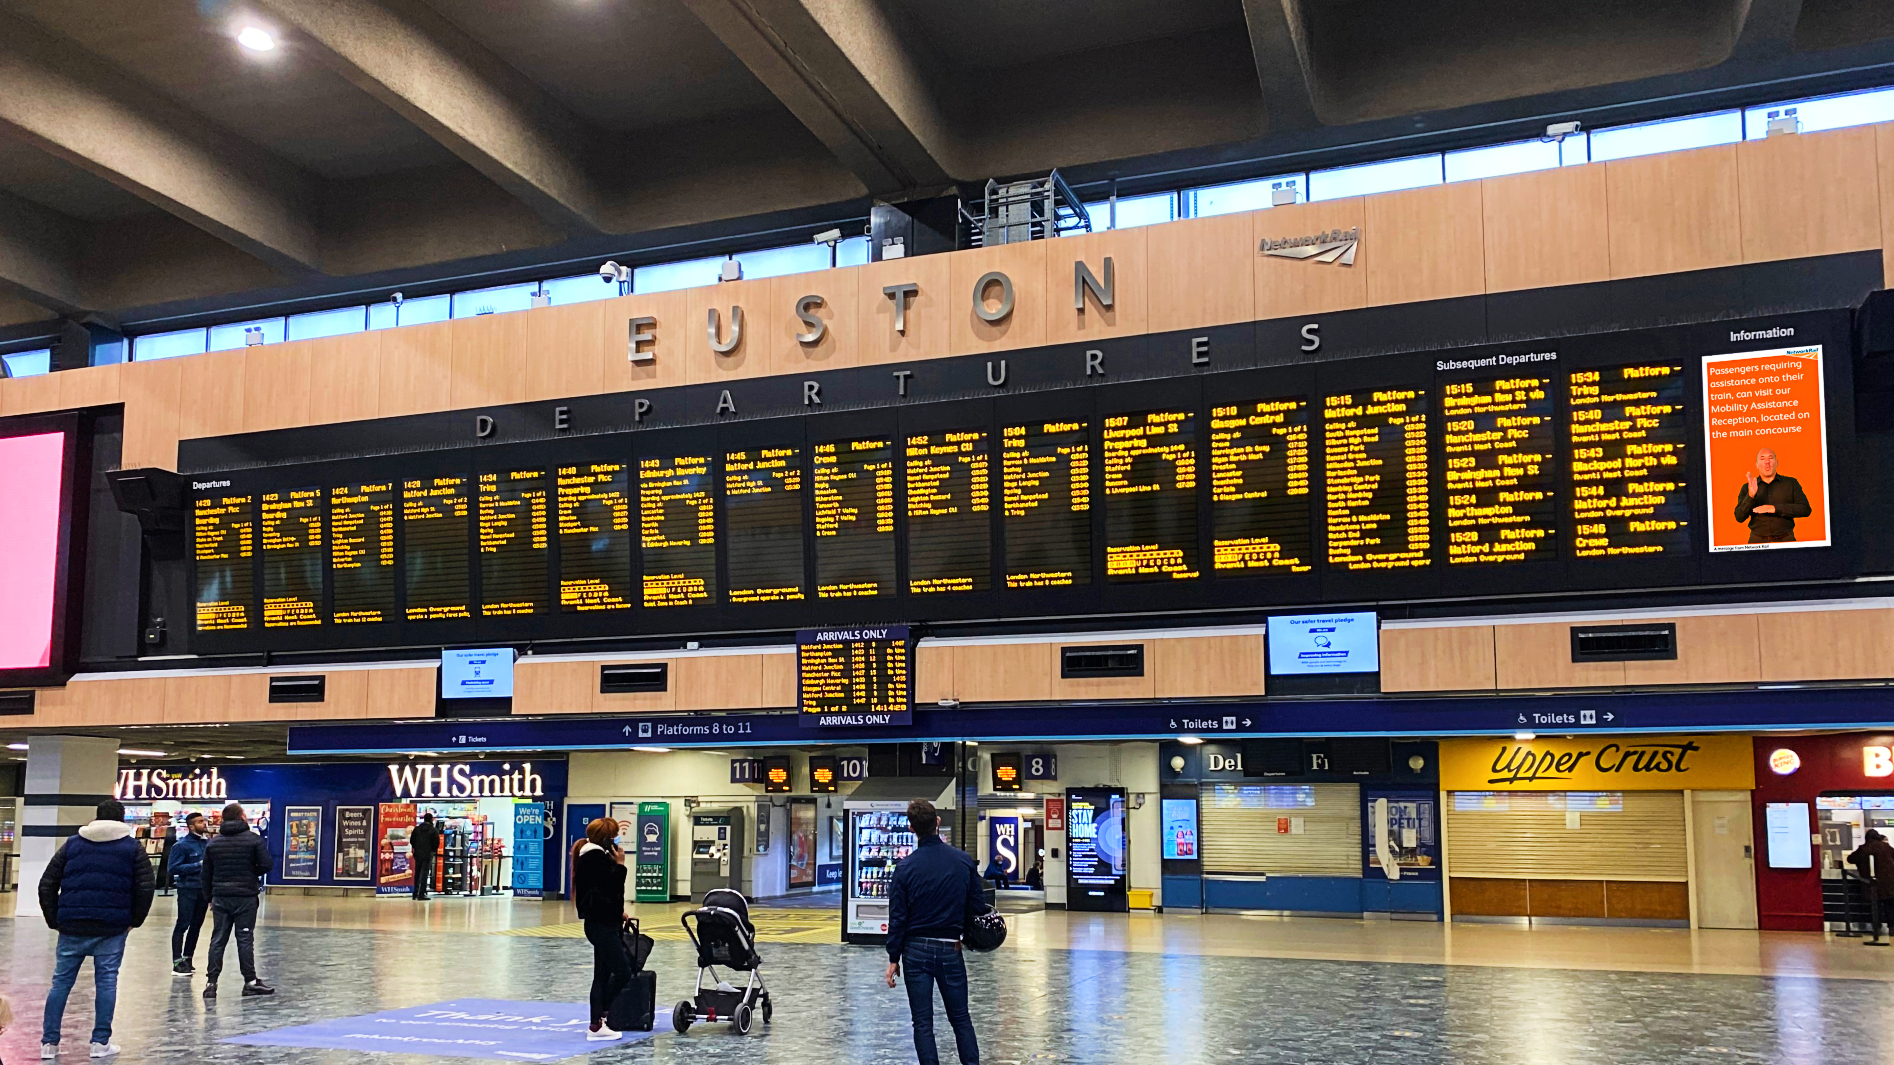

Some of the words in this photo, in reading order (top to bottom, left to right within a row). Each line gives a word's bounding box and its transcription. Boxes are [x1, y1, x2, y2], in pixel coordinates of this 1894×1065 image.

[628, 256, 1114, 362] EUSTON
[1730, 327, 1794, 341] Information
[1436, 356, 1496, 370] Subsequent
[1499, 352, 1557, 365] Departures
[1710, 365, 1759, 375] Passengers
[1761, 361, 1802, 371] requiring
[476, 322, 1320, 438] DEPARTURES
[1571, 372, 1600, 383] 15:34
[1623, 367, 1670, 379] Platform
[1710, 378, 1756, 388] assistance
[1782, 373, 1804, 381] their
[1446, 383, 1473, 394] 15:15
[1495, 379, 1539, 390] Platform
[1570, 385, 1599, 396] Tring
[1325, 396, 1352, 406] 15:15
[1373, 391, 1415, 402] Platform
[1445, 395, 1492, 407] Birmingham
[1494, 393, 1512, 402] New
[1515, 391, 1526, 400] St
[1530, 389, 1544, 399] via
[1711, 392, 1733, 400] train,
[1212, 406, 1237, 417] 15:10
[1257, 401, 1296, 413] Platform
[1324, 406, 1362, 419] Watford
[1365, 403, 1406, 414] Junction
[1572, 410, 1601, 421] 15:40
[1625, 405, 1672, 416] Platform
[1711, 404, 1748, 413] Mobility
[1750, 400, 1798, 410] Assistance
[1105, 417, 1128, 427] 15:07
[1148, 412, 1184, 423] Platform
[1211, 418, 1246, 429] Glasgow
[1249, 413, 1284, 425] Central
[1447, 420, 1474, 431] 15:20
[1497, 417, 1540, 427] Platform
[1571, 420, 1633, 433] Manchester
[1637, 418, 1659, 428] Picc
[1712, 416, 1759, 426] Reception,
[1761, 411, 1795, 421] located
[1003, 426, 1025, 437] 15:04
[1044, 423, 1079, 433] Platform
[1104, 427, 1143, 439] Liverpool
[1146, 425, 1164, 435] Lime
[1168, 423, 1178, 432] St
[1446, 431, 1503, 443] Manchester
[1508, 429, 1528, 438] Picc
[1730, 429, 1752, 437] main
[1755, 426, 1802, 435] concourse
[907, 436, 928, 445] 14:52
[946, 432, 979, 442] Platform
[1003, 439, 1025, 448] Tring
[1104, 439, 1147, 449] Preparing
[815, 445, 835, 453] 14:46
[852, 441, 883, 451] Platform
[1574, 448, 1603, 459] 15:43
[1627, 444, 1673, 455] Platform
[726, 452, 746, 461] 14:45
[762, 449, 792, 458] Platform
[1448, 457, 1475, 468] 15:23
[1498, 454, 1541, 465] Platform
[558, 467, 576, 475] 14:40
[591, 464, 619, 473] Platform
[641, 460, 659, 468] 14:43
[675, 457, 704, 465] Platform
[726, 462, 753, 471] Watford
[756, 460, 785, 469] Junction
[1573, 458, 1622, 472] Blackpool
[1625, 456, 1657, 467] North
[1661, 454, 1677, 465] via
[480, 474, 496, 482] 14:34
[511, 472, 538, 480] Platform
[640, 469, 674, 478] Edinburgh
[676, 466, 706, 475] Waverley
[1447, 469, 1500, 480] Birmingham
[1504, 467, 1524, 476] New
[1527, 465, 1539, 475] St
[192, 480, 230, 490] Departures
[479, 484, 496, 492] Tring
[1576, 486, 1604, 497] 15:44
[1628, 482, 1675, 494] Platform
[332, 495, 368, 504] Northampton
[1449, 494, 1476, 505] 15:24
[1499, 491, 1543, 502] Platform
[1574, 497, 1616, 509] Watford
[1620, 495, 1665, 506] Junction
[1448, 505, 1512, 517] Northampton
[1501, 529, 1544, 539] Platform
[1577, 524, 1606, 535] 15:46
[1630, 521, 1676, 532] Platform
[1449, 543, 1489, 554] Watford
[1493, 541, 1535, 552] Junction
[1576, 538, 1608, 547] Crewe
[816, 631, 860, 641] ARRIVALS
[863, 629, 887, 638] ONLY
[820, 716, 863, 725] ARRIVALS
[866, 715, 890, 723] ONLY
[1182, 719, 1218, 729] Toilets
[1533, 713, 1575, 724] Toilets
[657, 722, 709, 736] Platforms
[712, 723, 719, 734] 8
[723, 724, 734, 733] to
[738, 723, 751, 733] 11
[468, 735, 486, 743] Tickets
[841, 760, 860, 778] 10
[1031, 758, 1044, 776] 8
[1488, 746, 1591, 784] Upper
[1595, 741, 1700, 772] Crust
[1774, 759, 1795, 768] KING
[734, 762, 749, 778] 11
[388, 763, 543, 798] WHSmith
[381, 805, 415, 813] Christmas
[516, 816, 542, 824] OPEN
[1072, 810, 1093, 823] STAY
[996, 824, 1014, 835] WH
[1073, 823, 1097, 837] HOME
[996, 834, 1016, 873] S
[414, 1010, 557, 1023] Thank
